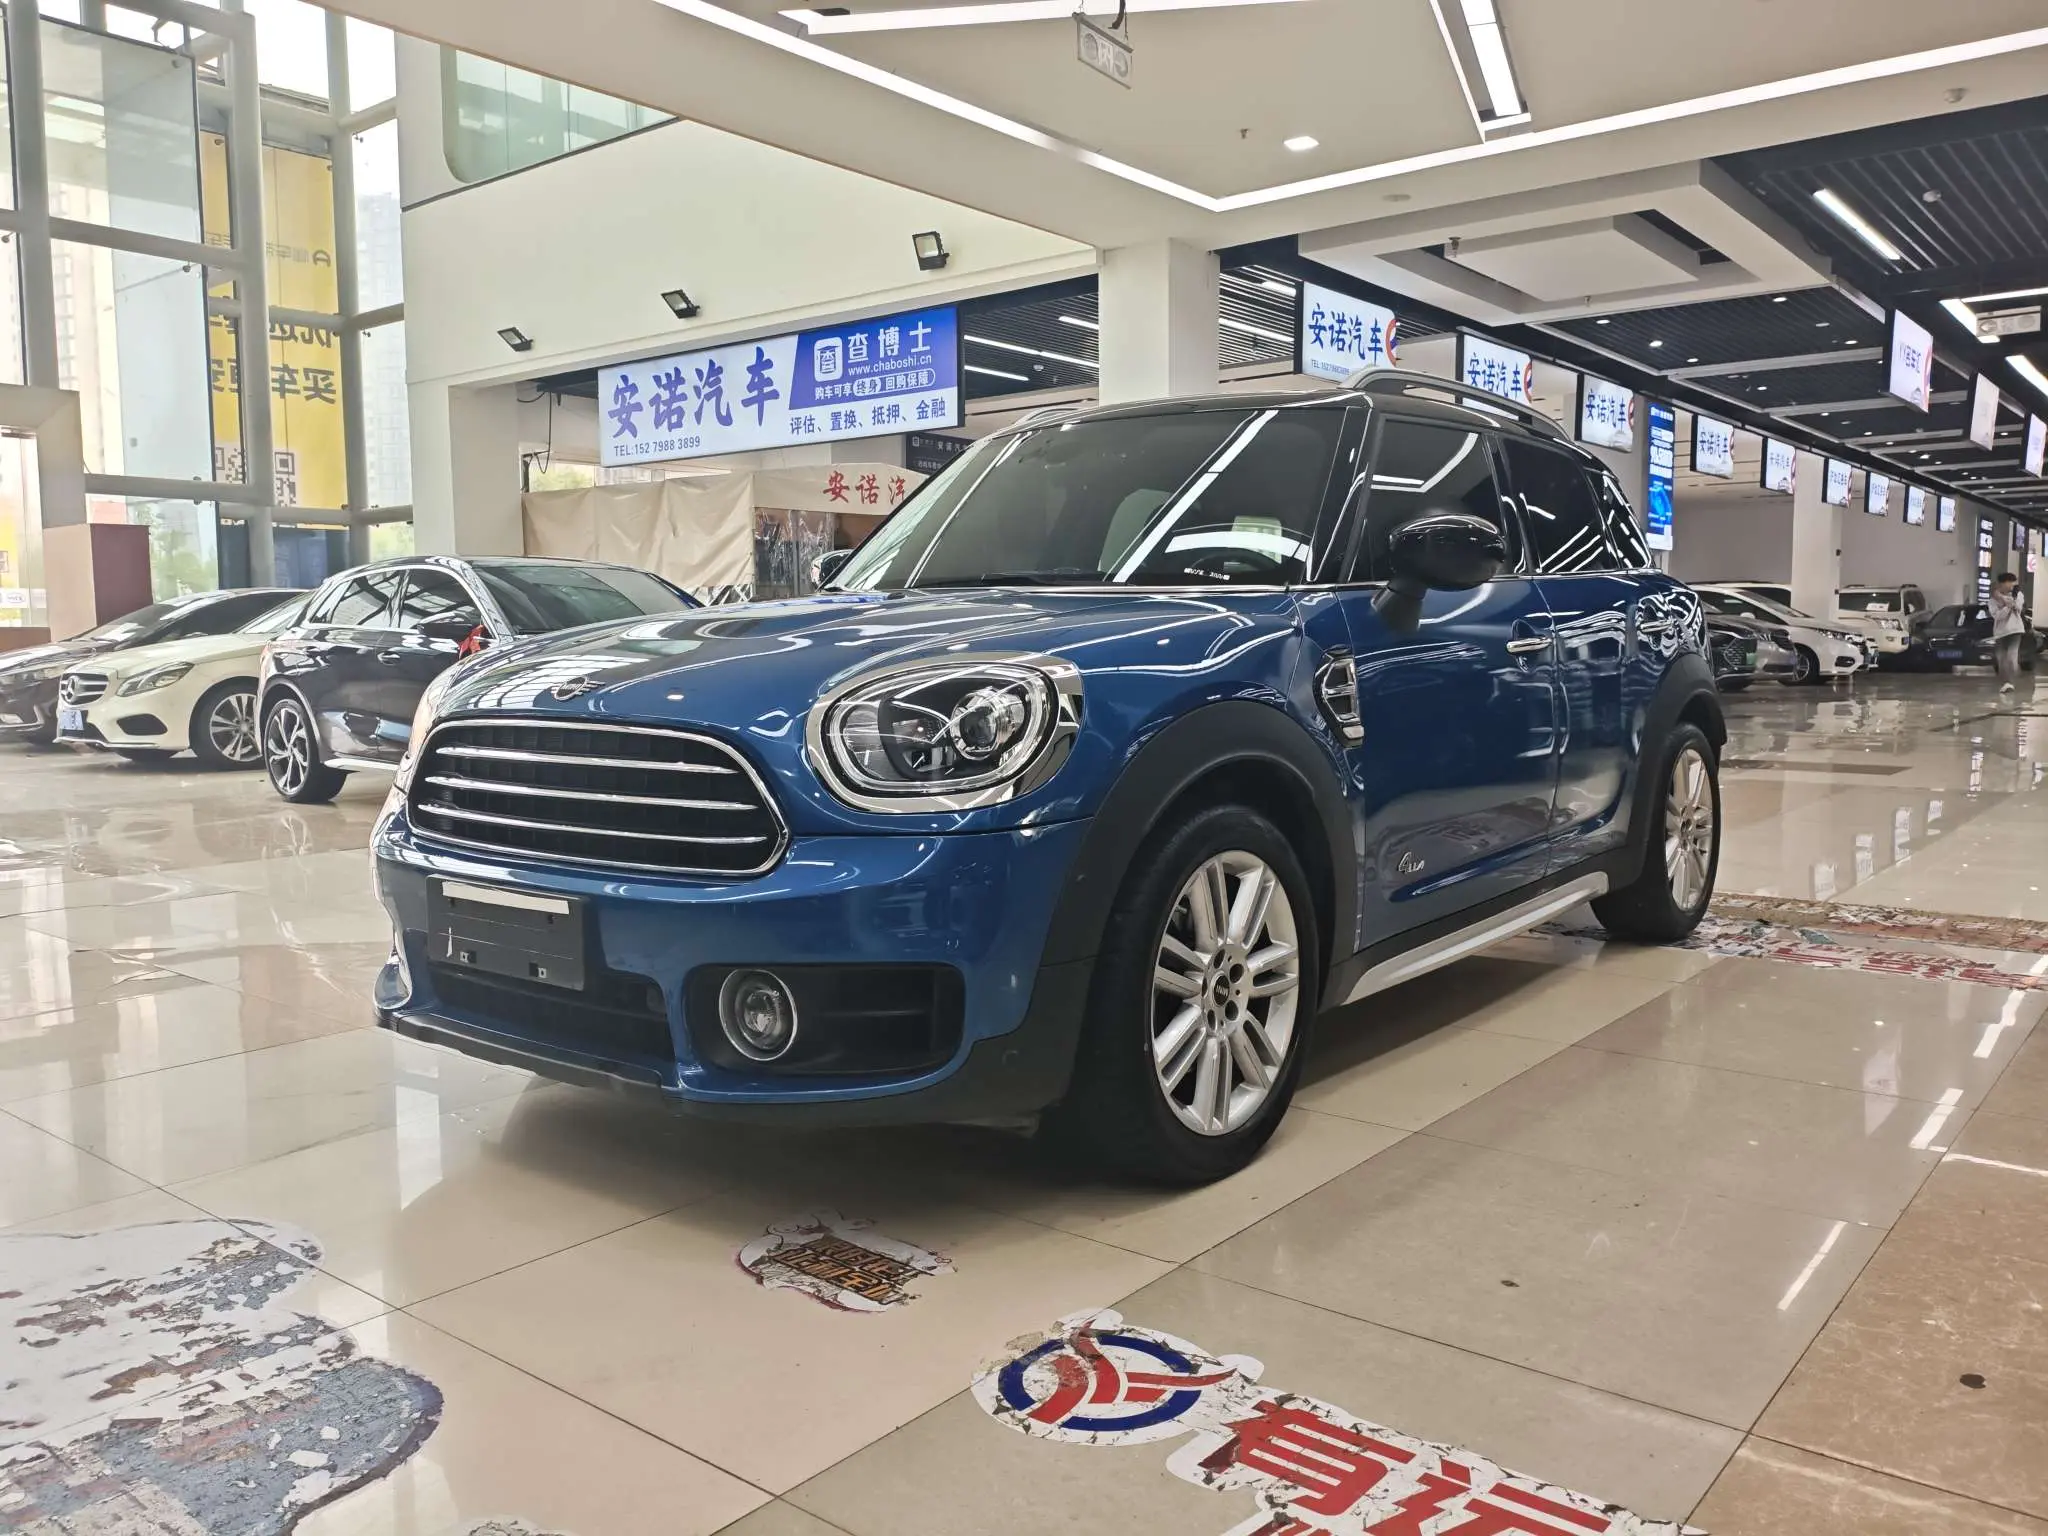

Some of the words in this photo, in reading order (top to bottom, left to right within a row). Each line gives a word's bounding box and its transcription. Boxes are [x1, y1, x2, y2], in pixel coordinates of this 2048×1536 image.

[848, 320, 932, 364] 查博士
[1307, 303, 1384, 365] 安诺汽车
[848, 354, 933, 377] www.chaboshi.cn
[607, 346, 780, 440] 安诺汽车
[1585, 388, 1627, 433] 安诺汽车
[653, 438, 676, 453] 7988
[677, 435, 701, 450] 3899
